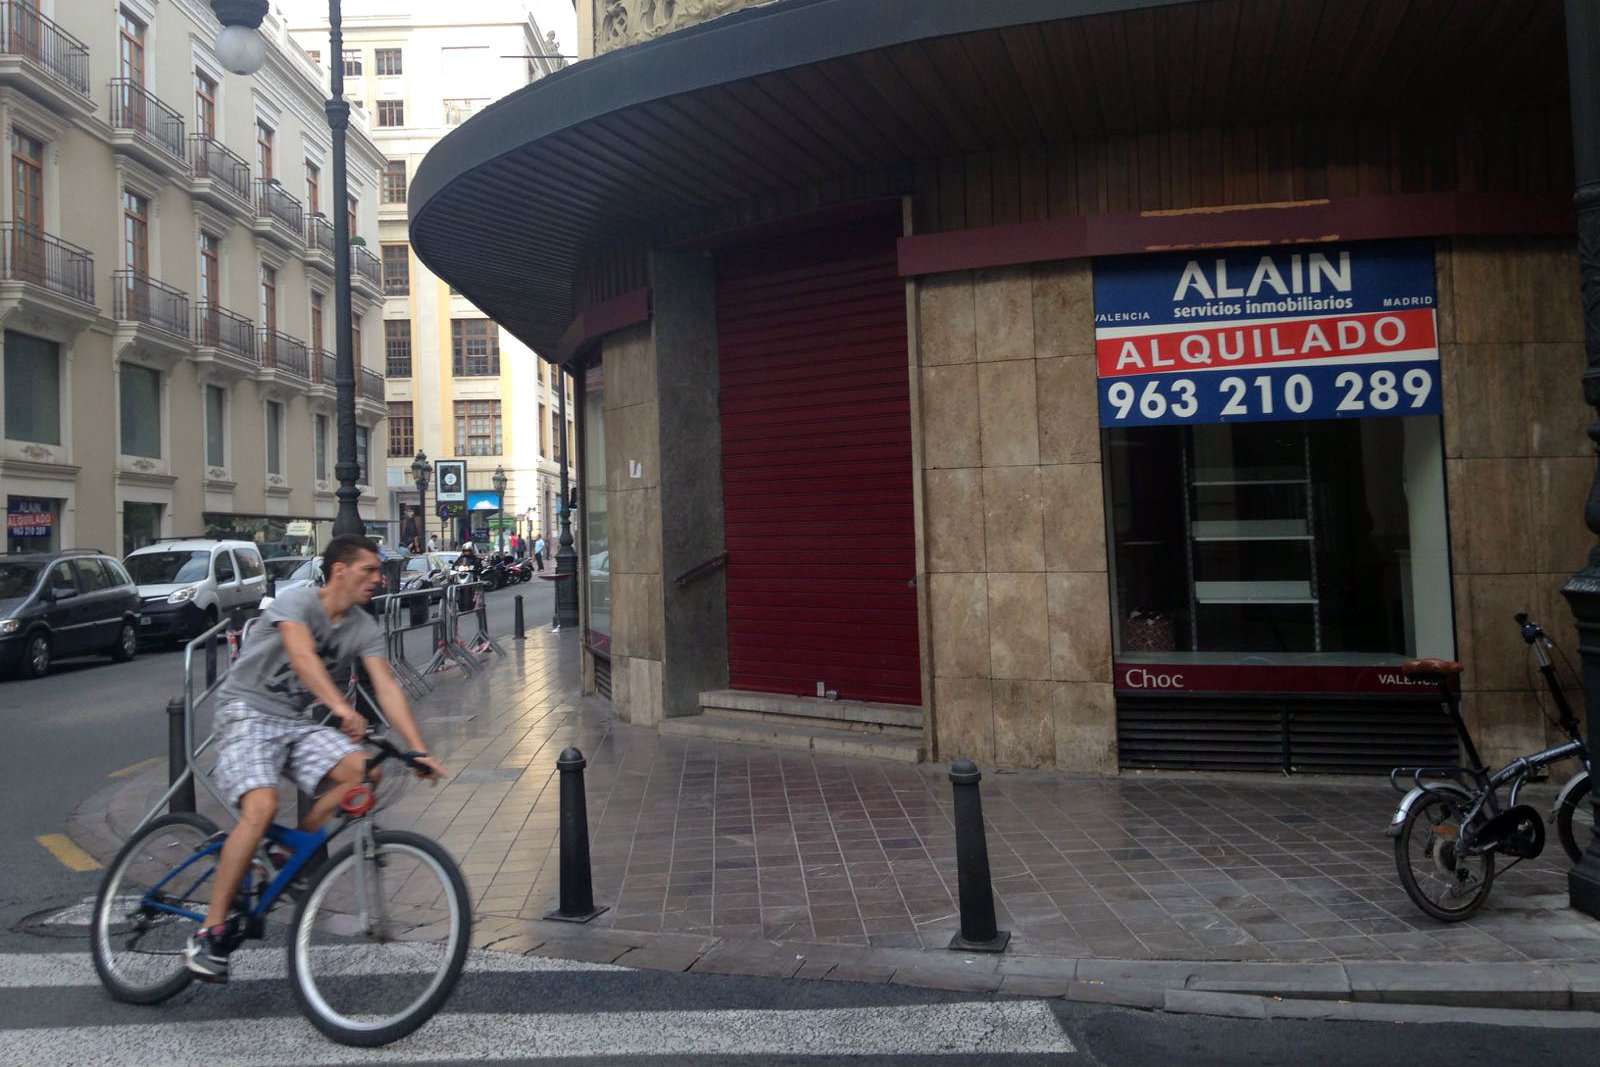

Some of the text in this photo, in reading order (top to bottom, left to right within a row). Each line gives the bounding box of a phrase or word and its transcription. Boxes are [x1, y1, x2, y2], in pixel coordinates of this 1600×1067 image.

[1172, 251, 1352, 301] ALAIN
[1173, 295, 1353, 318] servicios inmobiliarios
[1383, 296, 1433, 307] MADRID
[1116, 316, 1406, 370] ALQUILADO
[1108, 368, 1433, 420] 963 210 289
[1125, 669, 1185, 688] Choc
